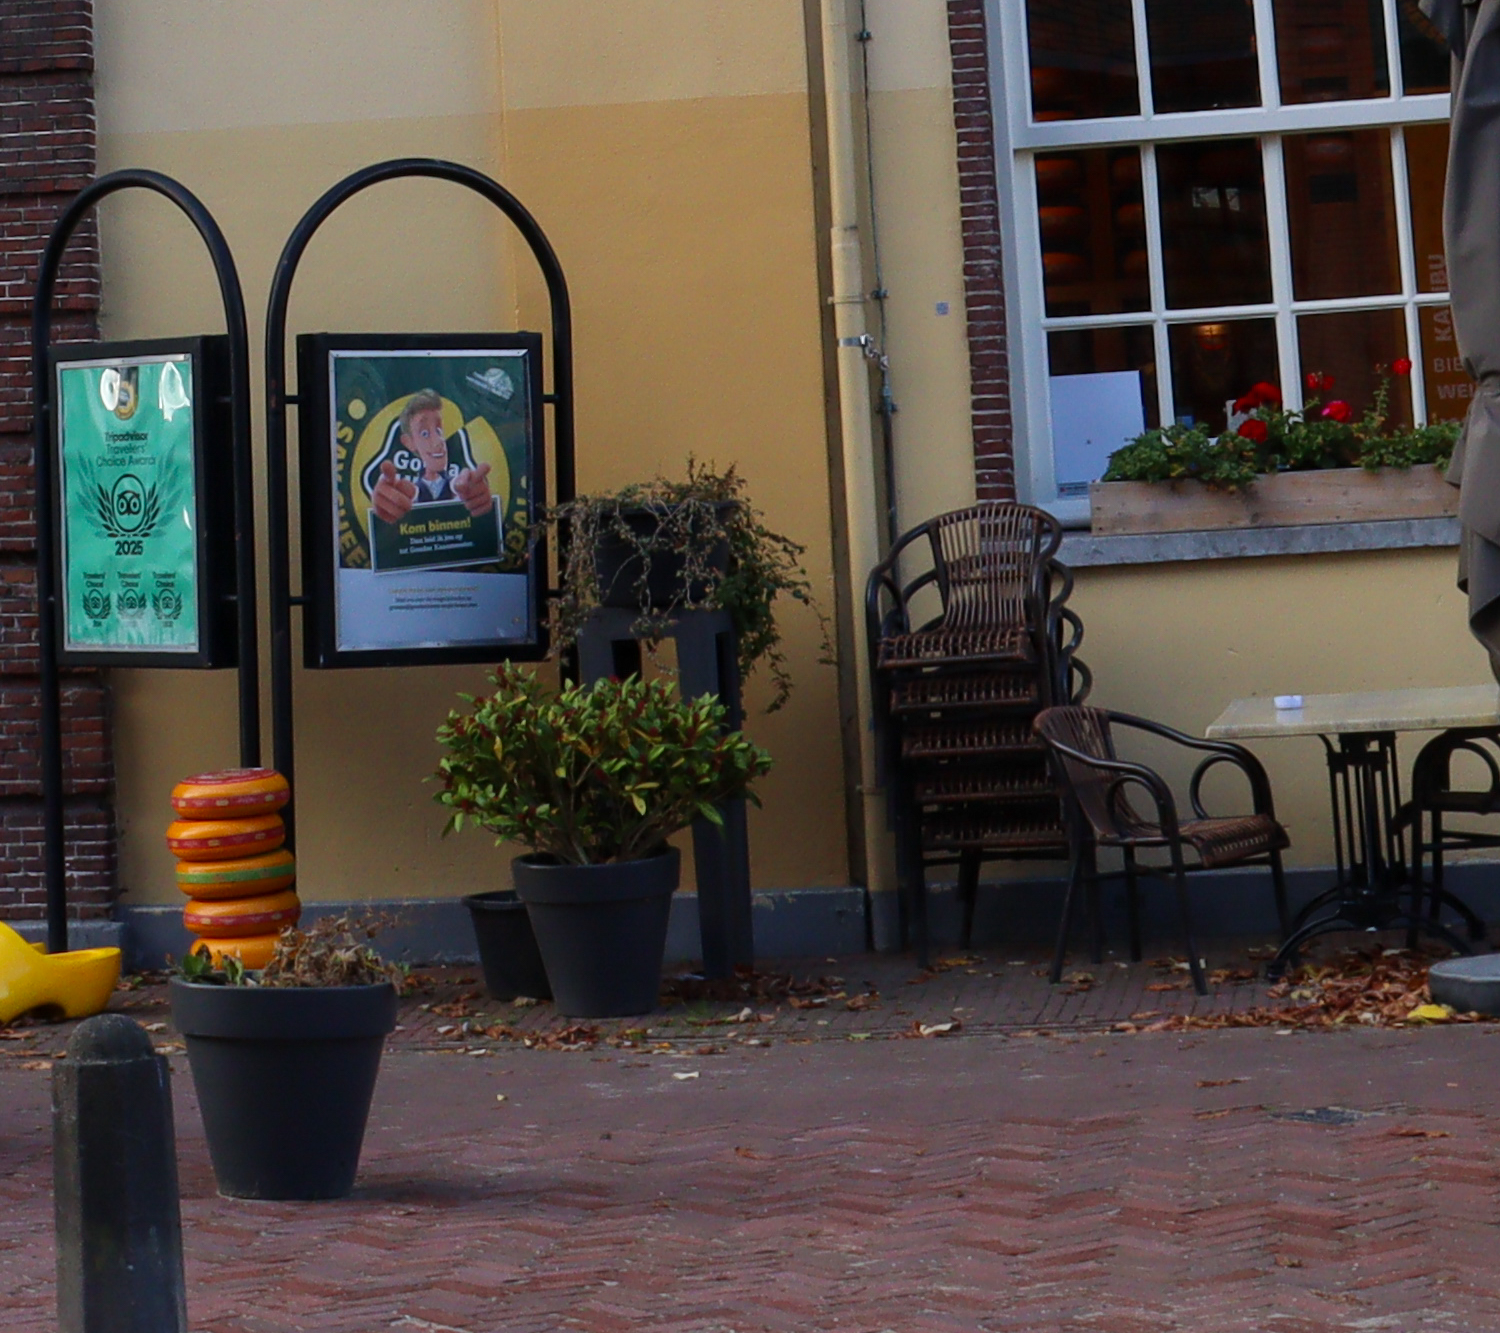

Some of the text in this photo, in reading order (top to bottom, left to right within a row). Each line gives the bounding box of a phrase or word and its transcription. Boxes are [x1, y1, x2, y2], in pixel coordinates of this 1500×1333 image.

[1428, 253, 1453, 341] KAIBU
[96, 456, 126, 467] Choice
[393, 451, 460, 478] Goa
[400, 517, 472, 536] Kom binnen!
[115, 540, 144, 556] 2025
